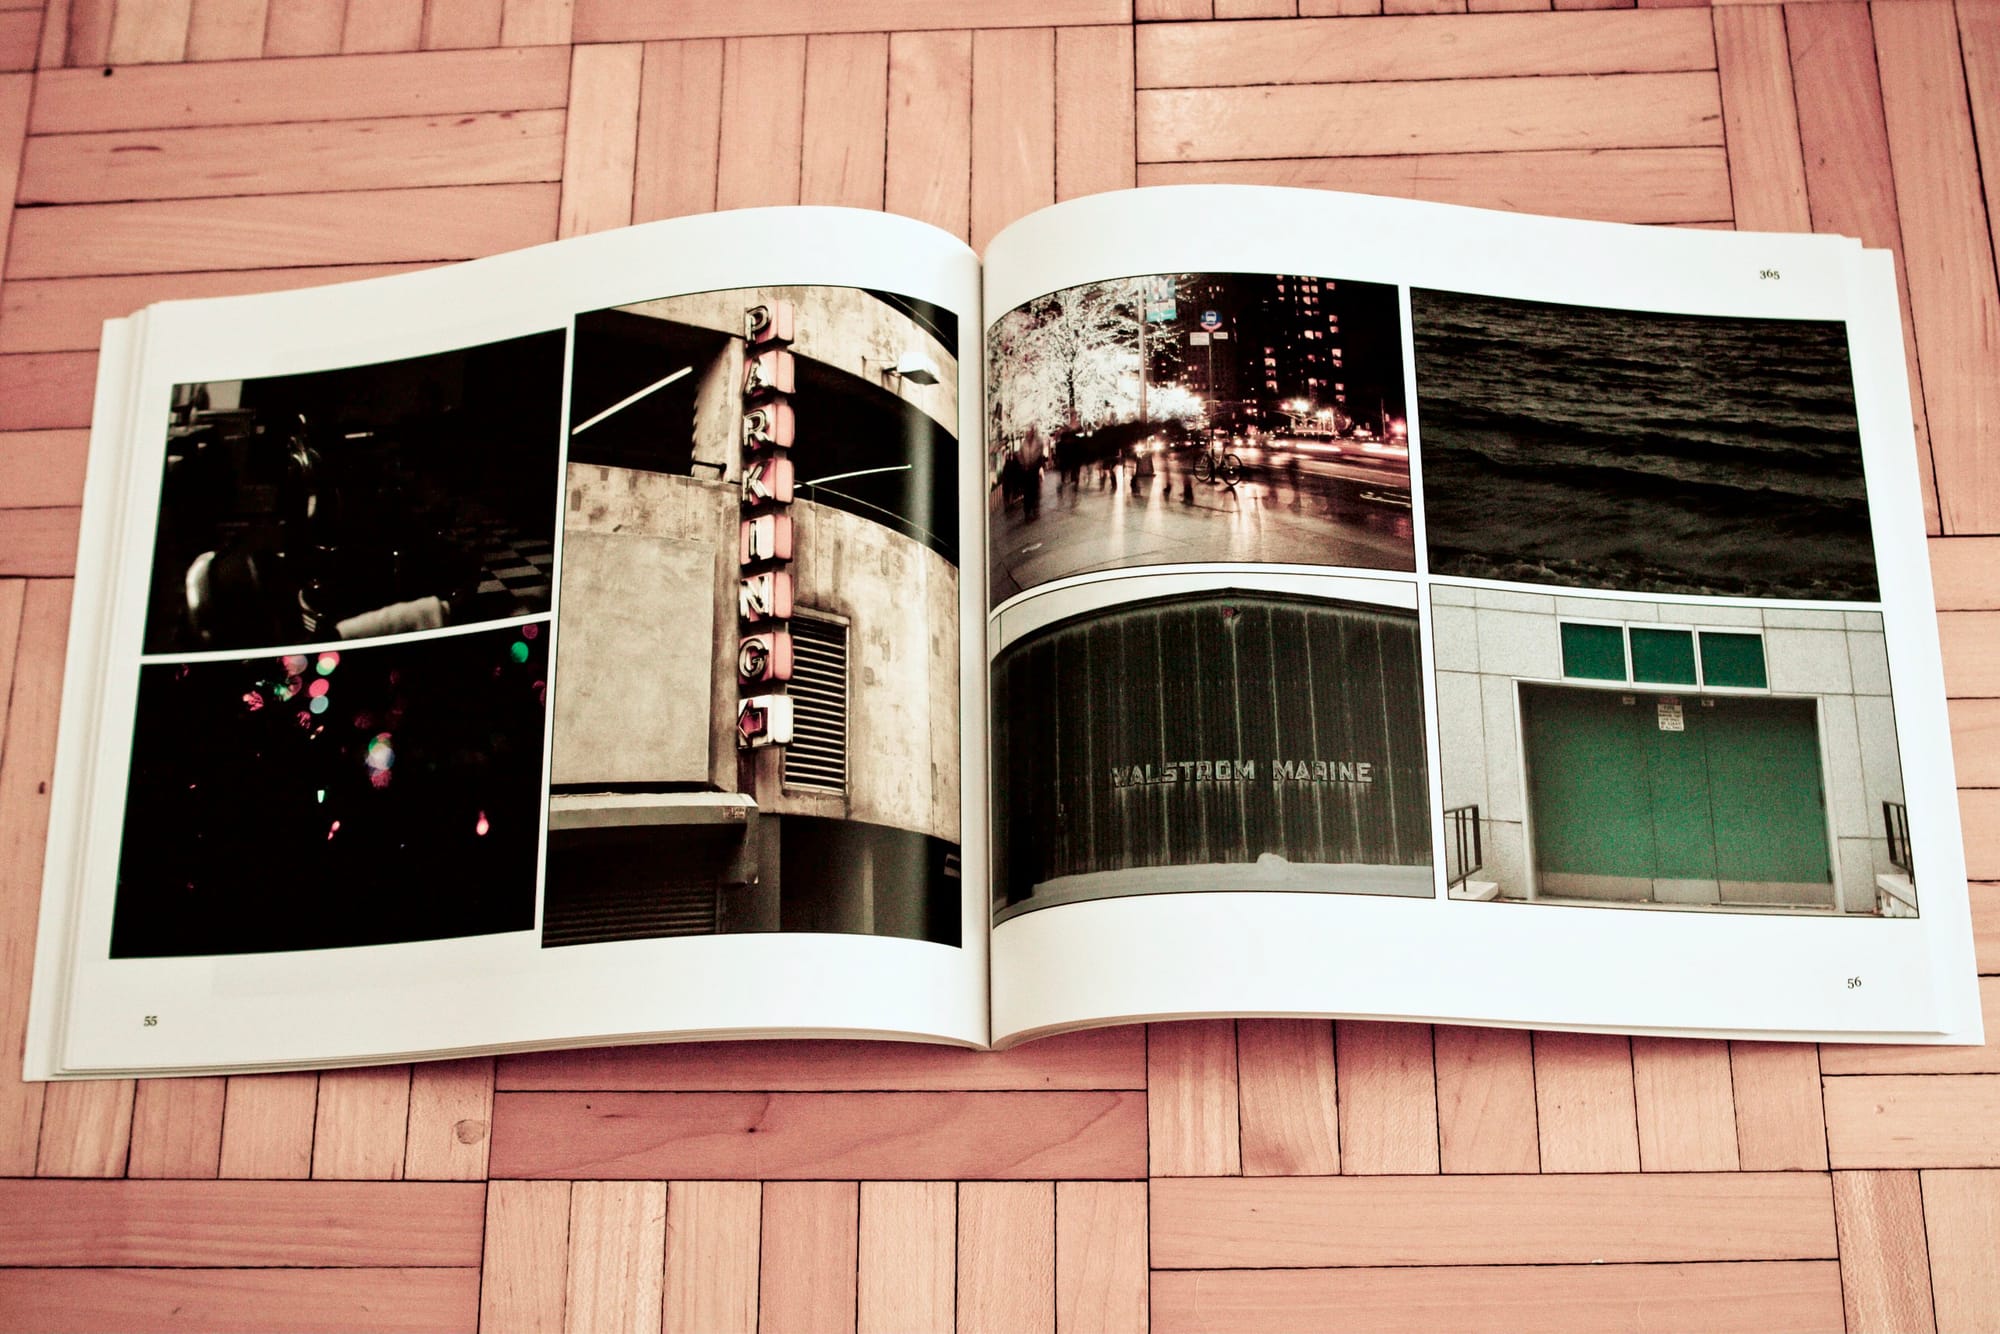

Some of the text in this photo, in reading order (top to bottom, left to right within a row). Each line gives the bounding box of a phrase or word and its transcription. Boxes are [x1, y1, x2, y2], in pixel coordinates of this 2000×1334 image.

[1760, 268, 1780, 280] 365
[738, 305, 773, 679] PARKING
[1111, 759, 1373, 788] WALSTROM MARINE
[1847, 975, 1862, 990] 56
[143, 1015, 158, 1027] 55
